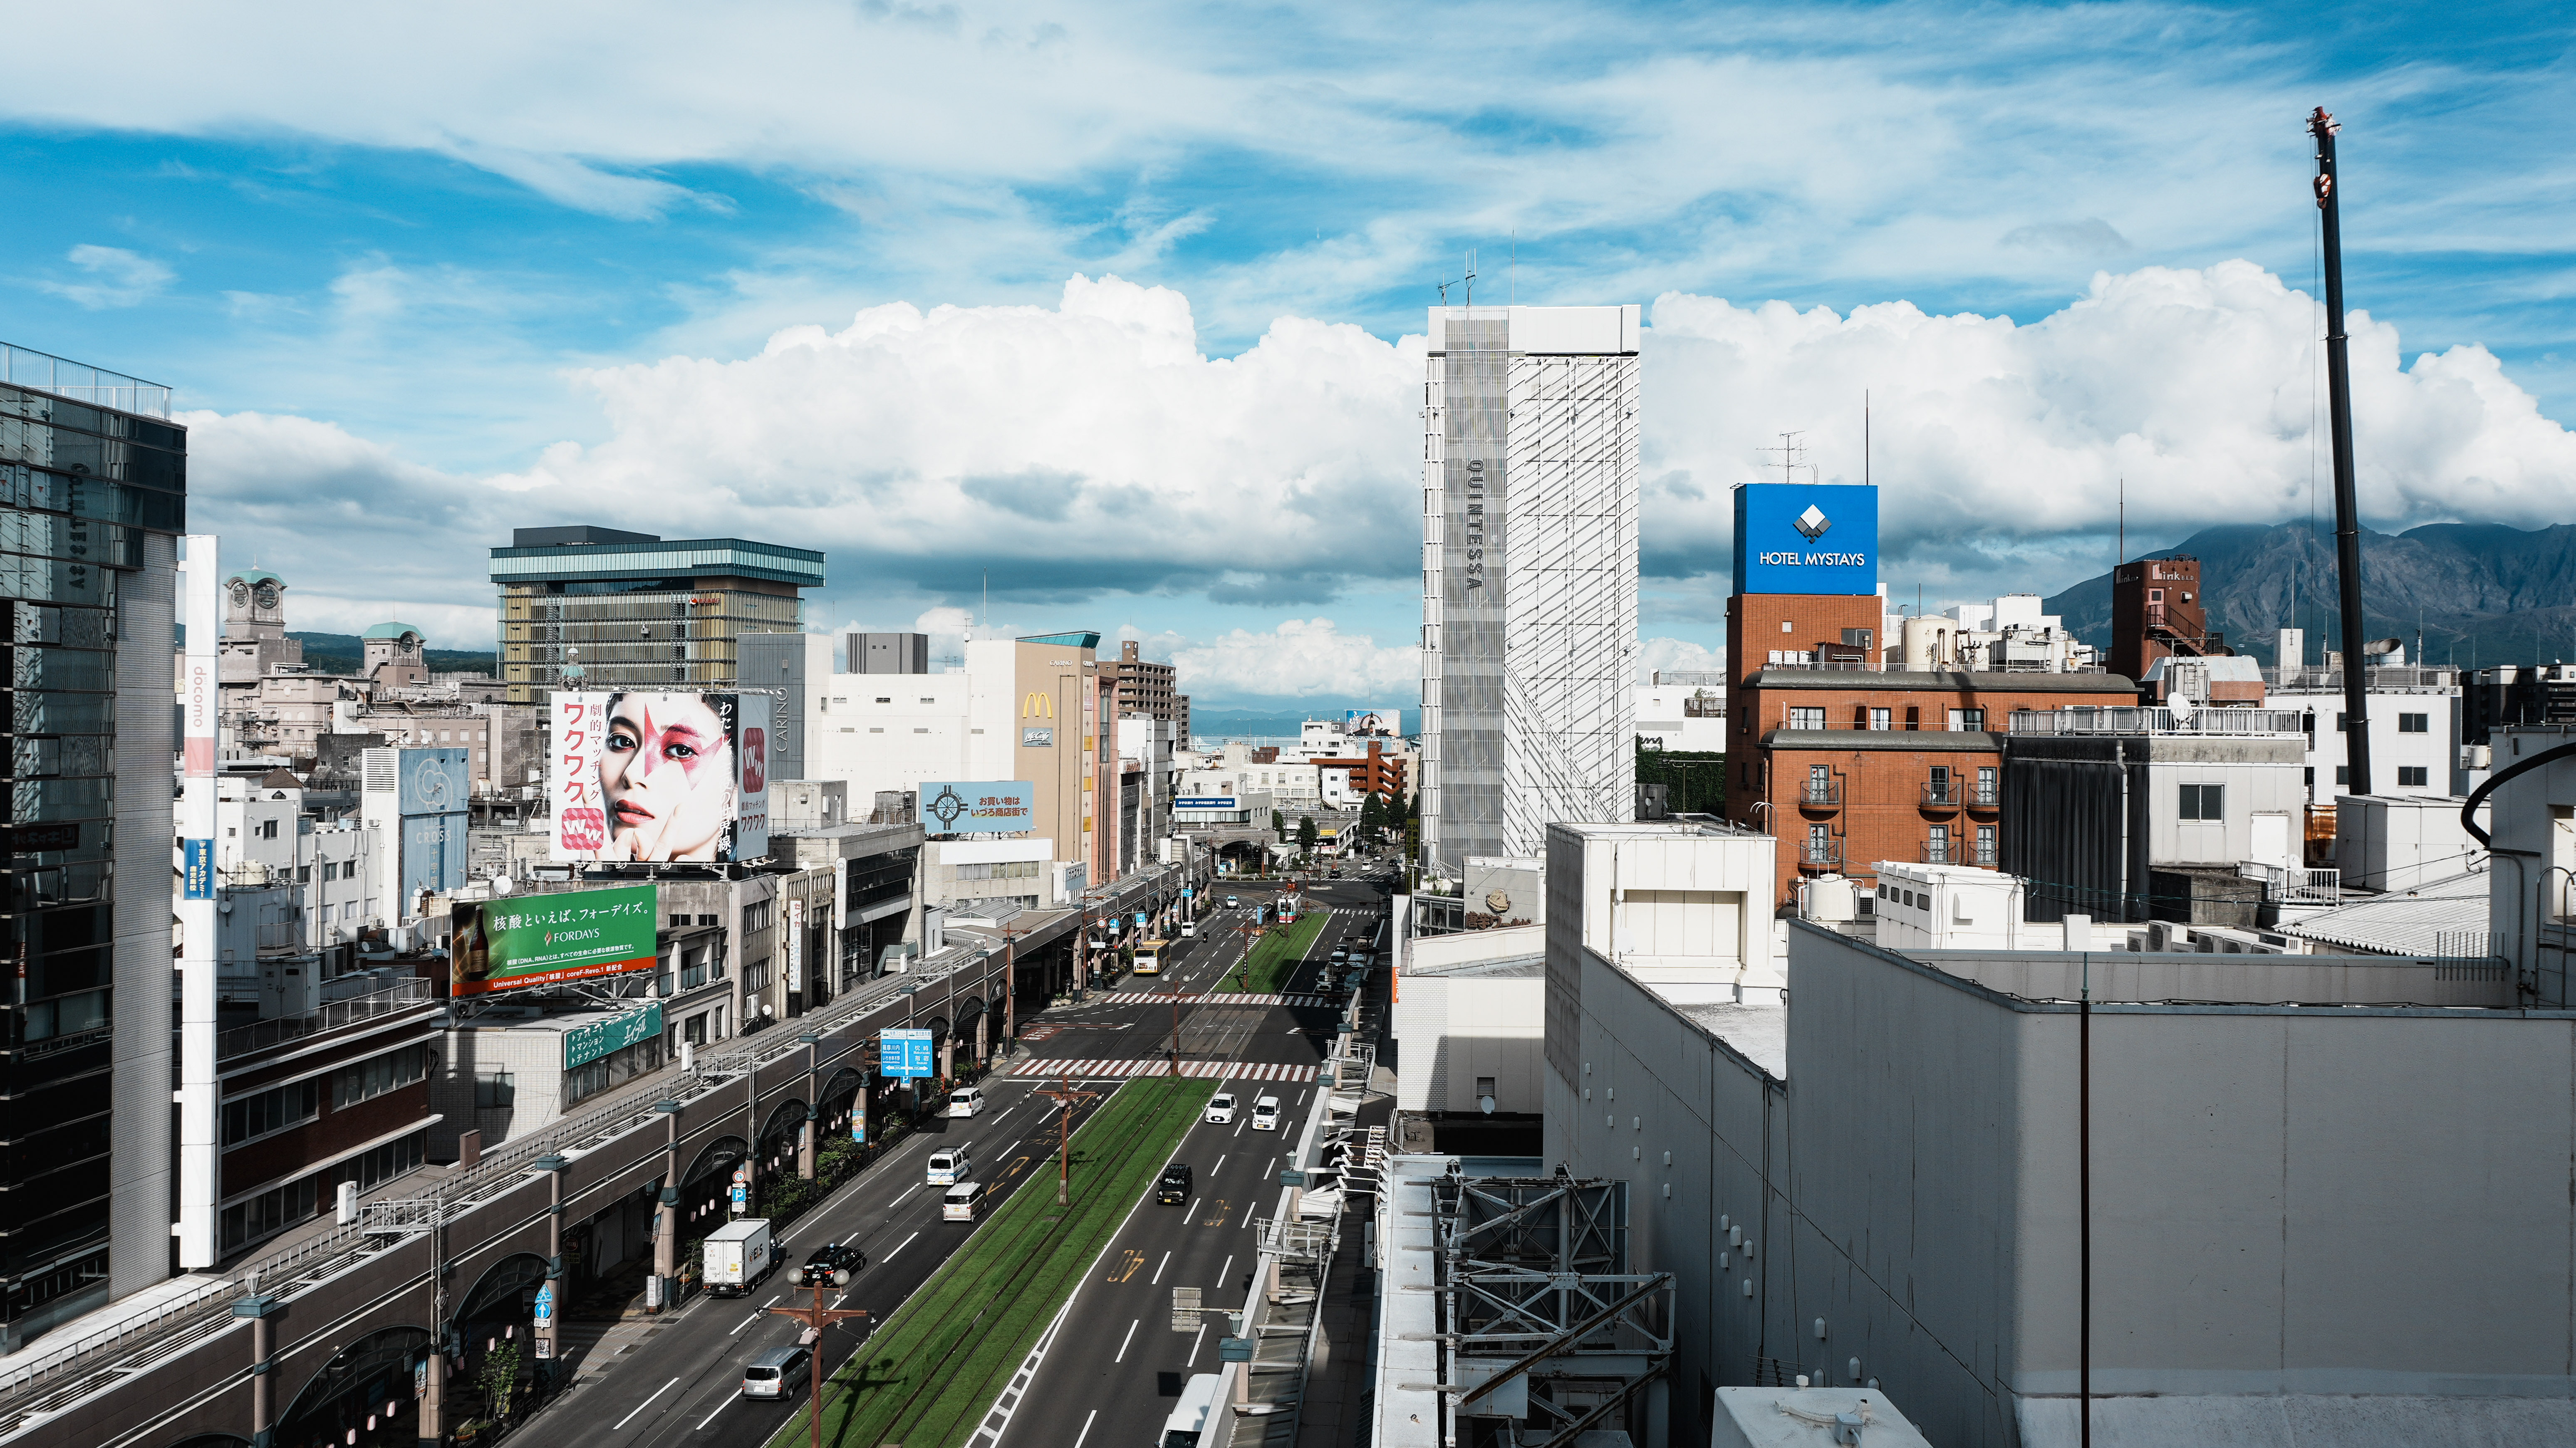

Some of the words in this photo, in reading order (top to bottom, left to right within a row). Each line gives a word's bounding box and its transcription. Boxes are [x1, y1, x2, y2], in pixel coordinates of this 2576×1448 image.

[1467, 460, 1484, 590] QUINTESSA
[1760, 552, 1801, 565] HOTEL
[1805, 552, 1865, 566] MYSTAYS
[193, 666, 206, 727] docomo
[776, 687, 788, 752] CARINO
[564, 703, 584, 803] ワクワク
[590, 704, 602, 801] 劇的マッチング
[741, 799, 765, 812] 劇的マッチング
[979, 797, 1020, 806] お買い物は
[971, 807, 1028, 817] いづろ商店街で
[741, 813, 765, 833] ワクワク
[416, 829, 451, 844] CROSS
[198, 849, 207, 898] 東京アカデミー
[493, 901, 649, 932] 核酸といえば、フォーデイズ。
[554, 928, 600, 943] FORDAYS
[493, 978, 522, 989] Universal
[606, 964, 623, 972] 新配合
[622, 1014, 646, 1046] エイブル
[577, 1036, 604, 1050] マンション
[577, 1046, 604, 1063] テナント
[736, 1190, 743, 1201] P
[754, 1243, 763, 1261] ELS
[1107, 1250, 1144, 1282] 40
